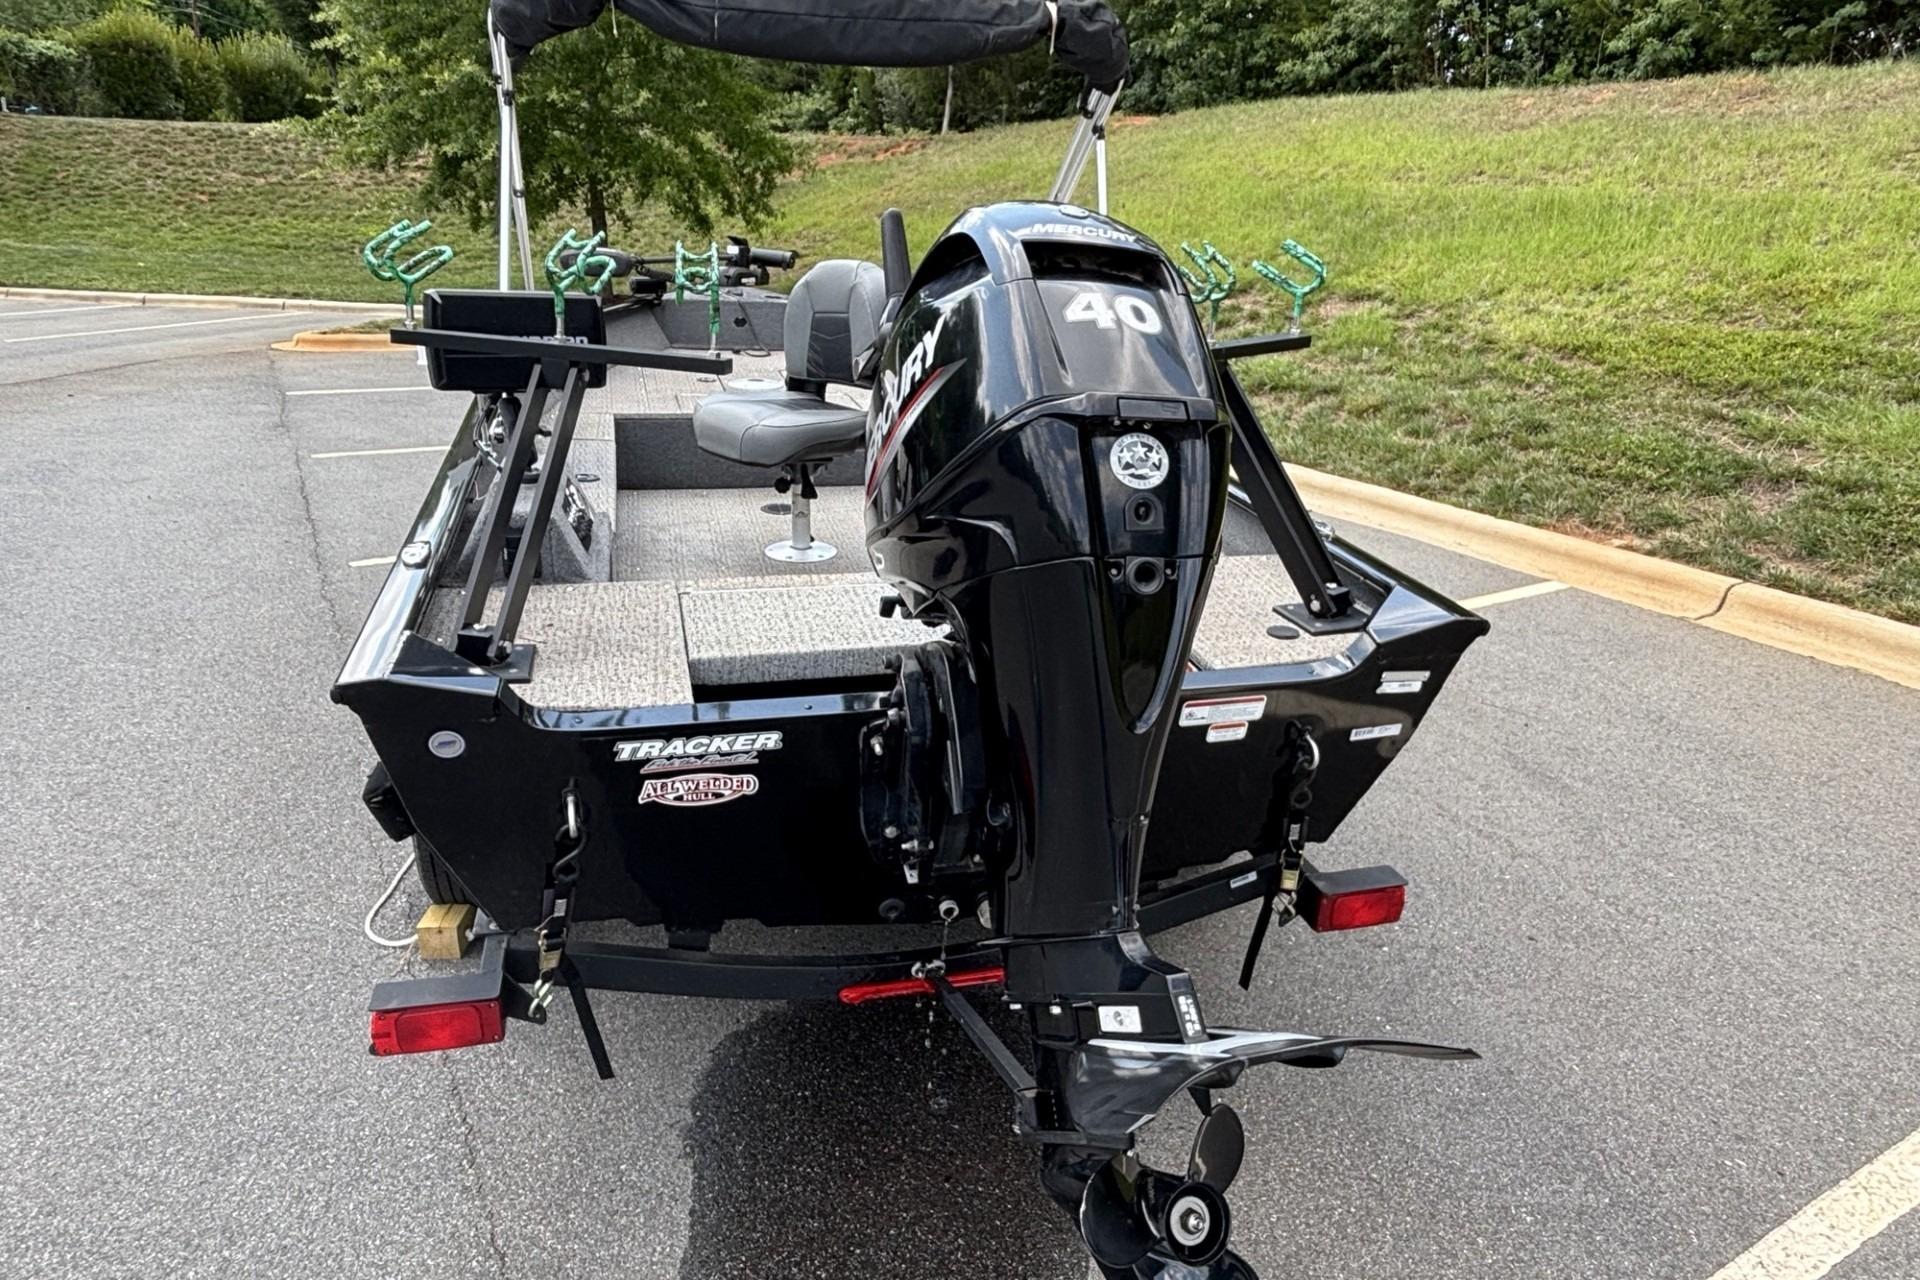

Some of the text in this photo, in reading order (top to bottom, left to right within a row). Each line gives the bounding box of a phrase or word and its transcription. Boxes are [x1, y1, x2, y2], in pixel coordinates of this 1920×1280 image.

[1031, 223, 1138, 243] MERCURY
[1063, 291, 1163, 335] 40
[613, 732, 782, 760] TRACKER
[642, 775, 755, 799] ALL WELDED
[683, 792, 716, 801] HULL
